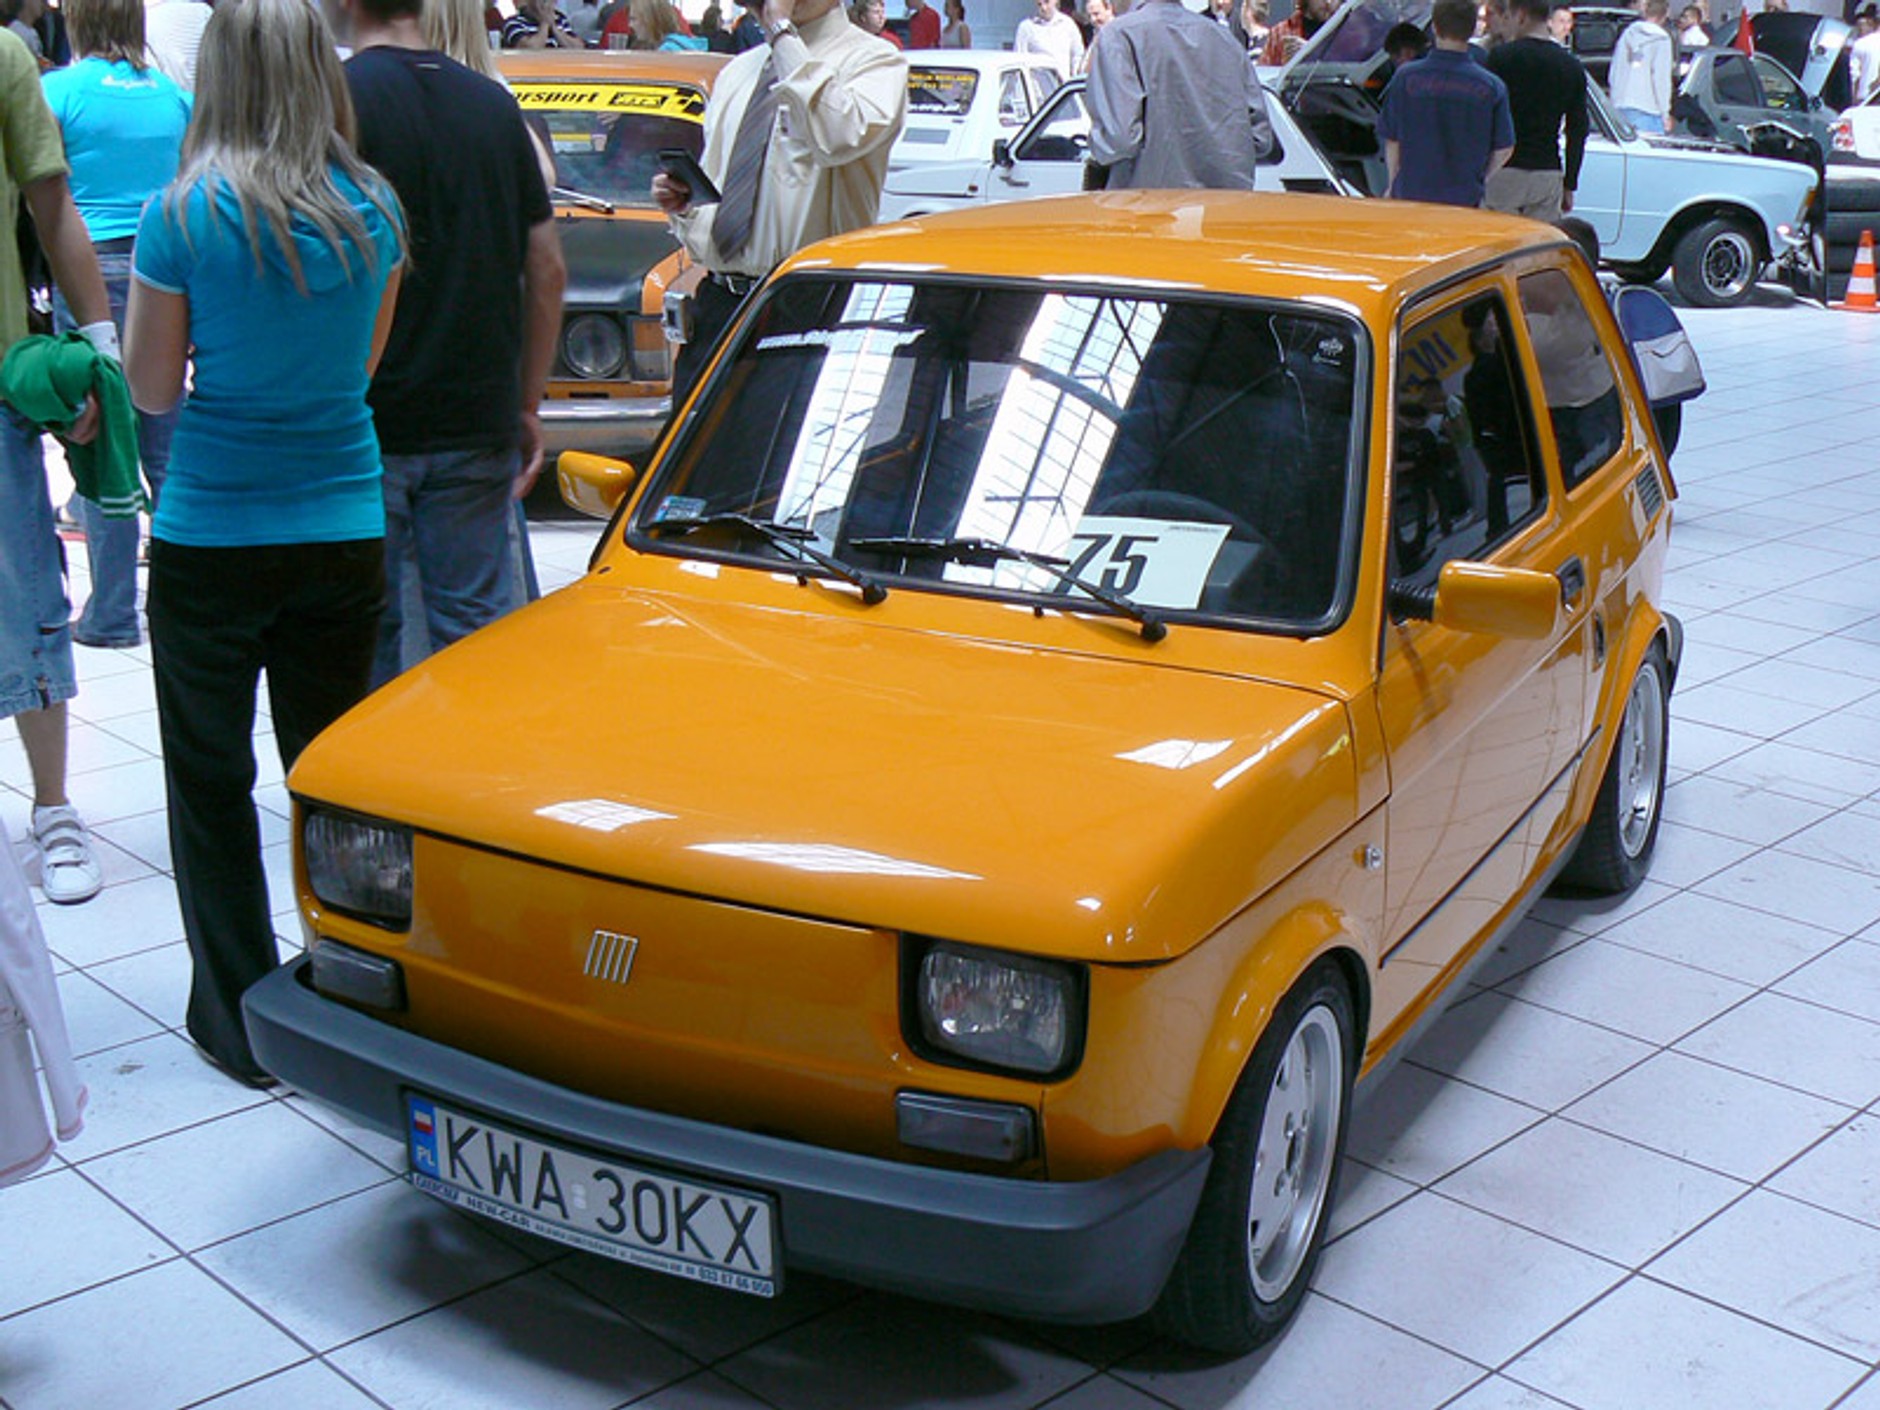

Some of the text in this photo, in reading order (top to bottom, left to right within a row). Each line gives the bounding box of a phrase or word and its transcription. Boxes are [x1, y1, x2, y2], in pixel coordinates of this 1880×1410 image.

[1052, 533, 1159, 597] 75
[417, 1146, 435, 1167] PL
[446, 1117, 760, 1271] KWA 30KX
